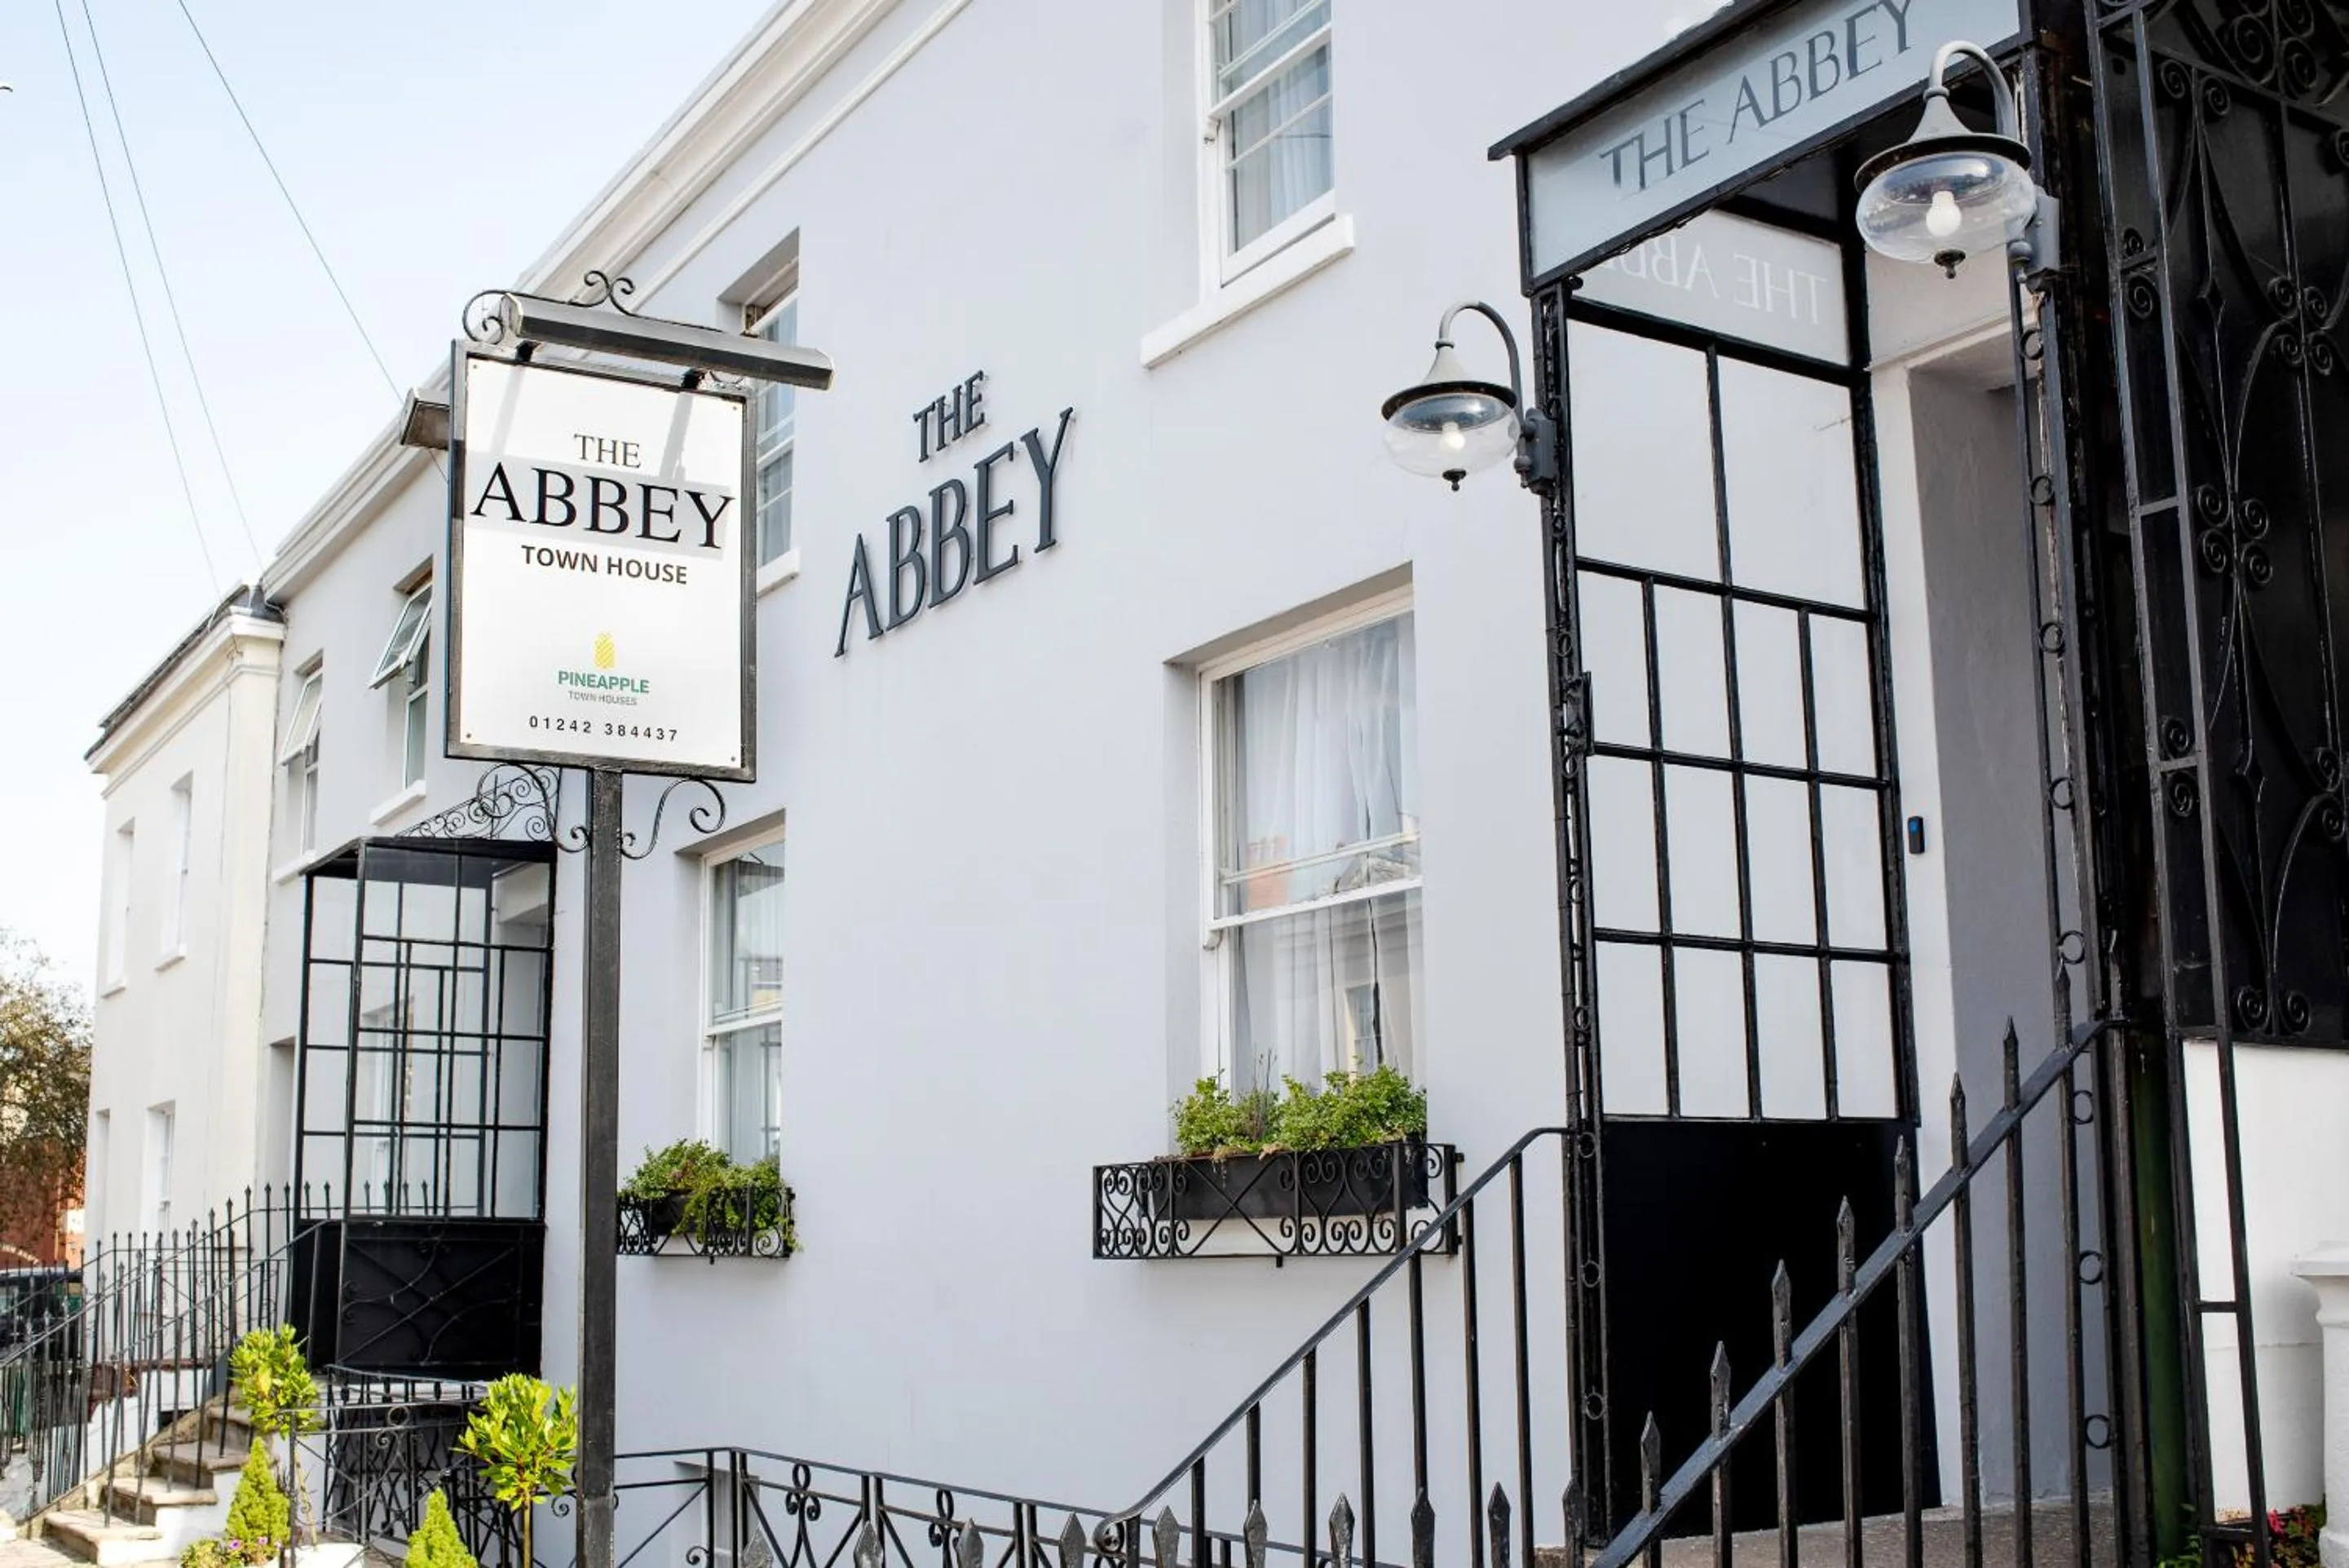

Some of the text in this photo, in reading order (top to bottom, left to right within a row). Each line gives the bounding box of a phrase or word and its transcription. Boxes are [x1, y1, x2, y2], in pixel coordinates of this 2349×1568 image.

[1600, 0, 1912, 192] THE ABBEY
[913, 369, 985, 462] THE
[574, 433, 642, 469] THE
[470, 462, 735, 549] ABBEY
[834, 406, 1074, 658] ABBEY
[521, 545, 688, 585] TOWN HOUSE
[559, 670, 650, 693] PINEAPPLE
[568, 691, 638, 706] TOWN HOUSES
[529, 715, 678, 742] 01242 384437
